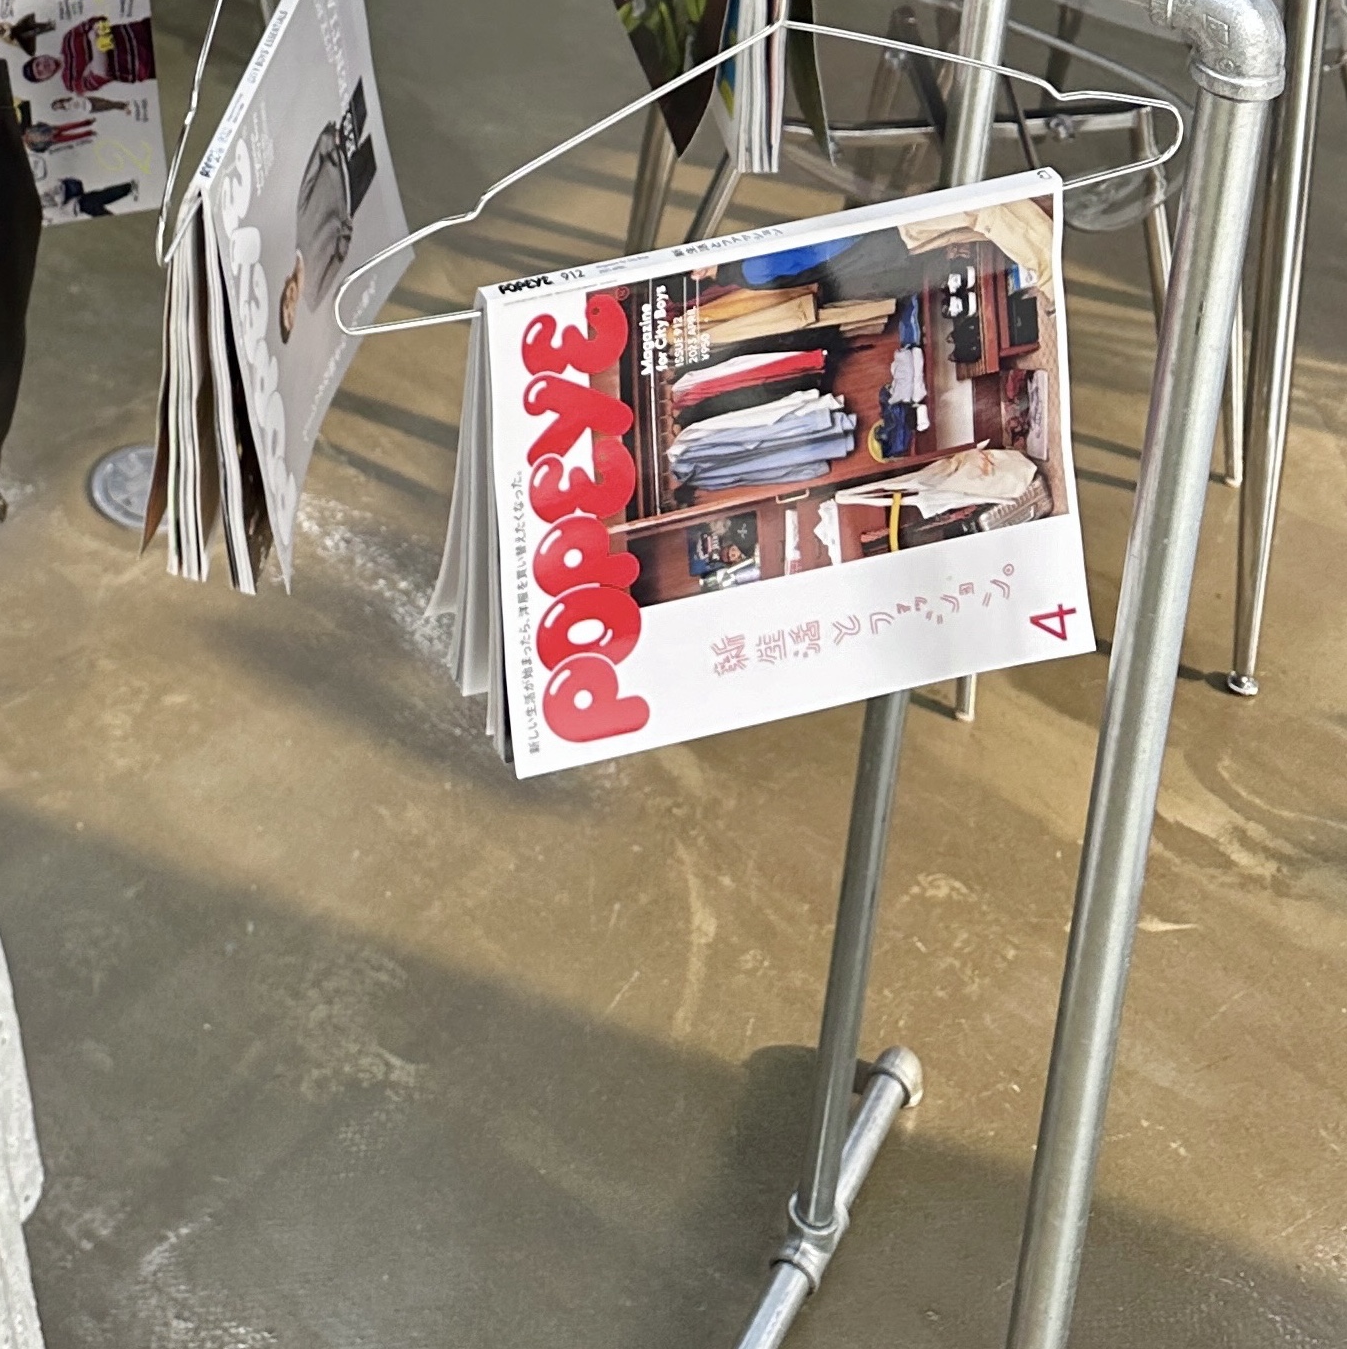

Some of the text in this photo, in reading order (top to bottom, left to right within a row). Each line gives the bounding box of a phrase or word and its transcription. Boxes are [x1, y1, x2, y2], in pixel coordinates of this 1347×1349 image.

[498, 274, 554, 296] POPEYE
[559, 268, 586, 282] 912
[218, 136, 298, 538] POPEYE
[638, 303, 655, 376] Magazine
[654, 284, 670, 372] for City Boys
[672, 315, 685, 368] ISSUE 912
[686, 306, 699, 364] 2023 APRIL
[520, 293, 651, 744] POPEYE
[710, 563, 1015, 677] 新生活とファッション。
[1029, 602, 1077, 642] 4
